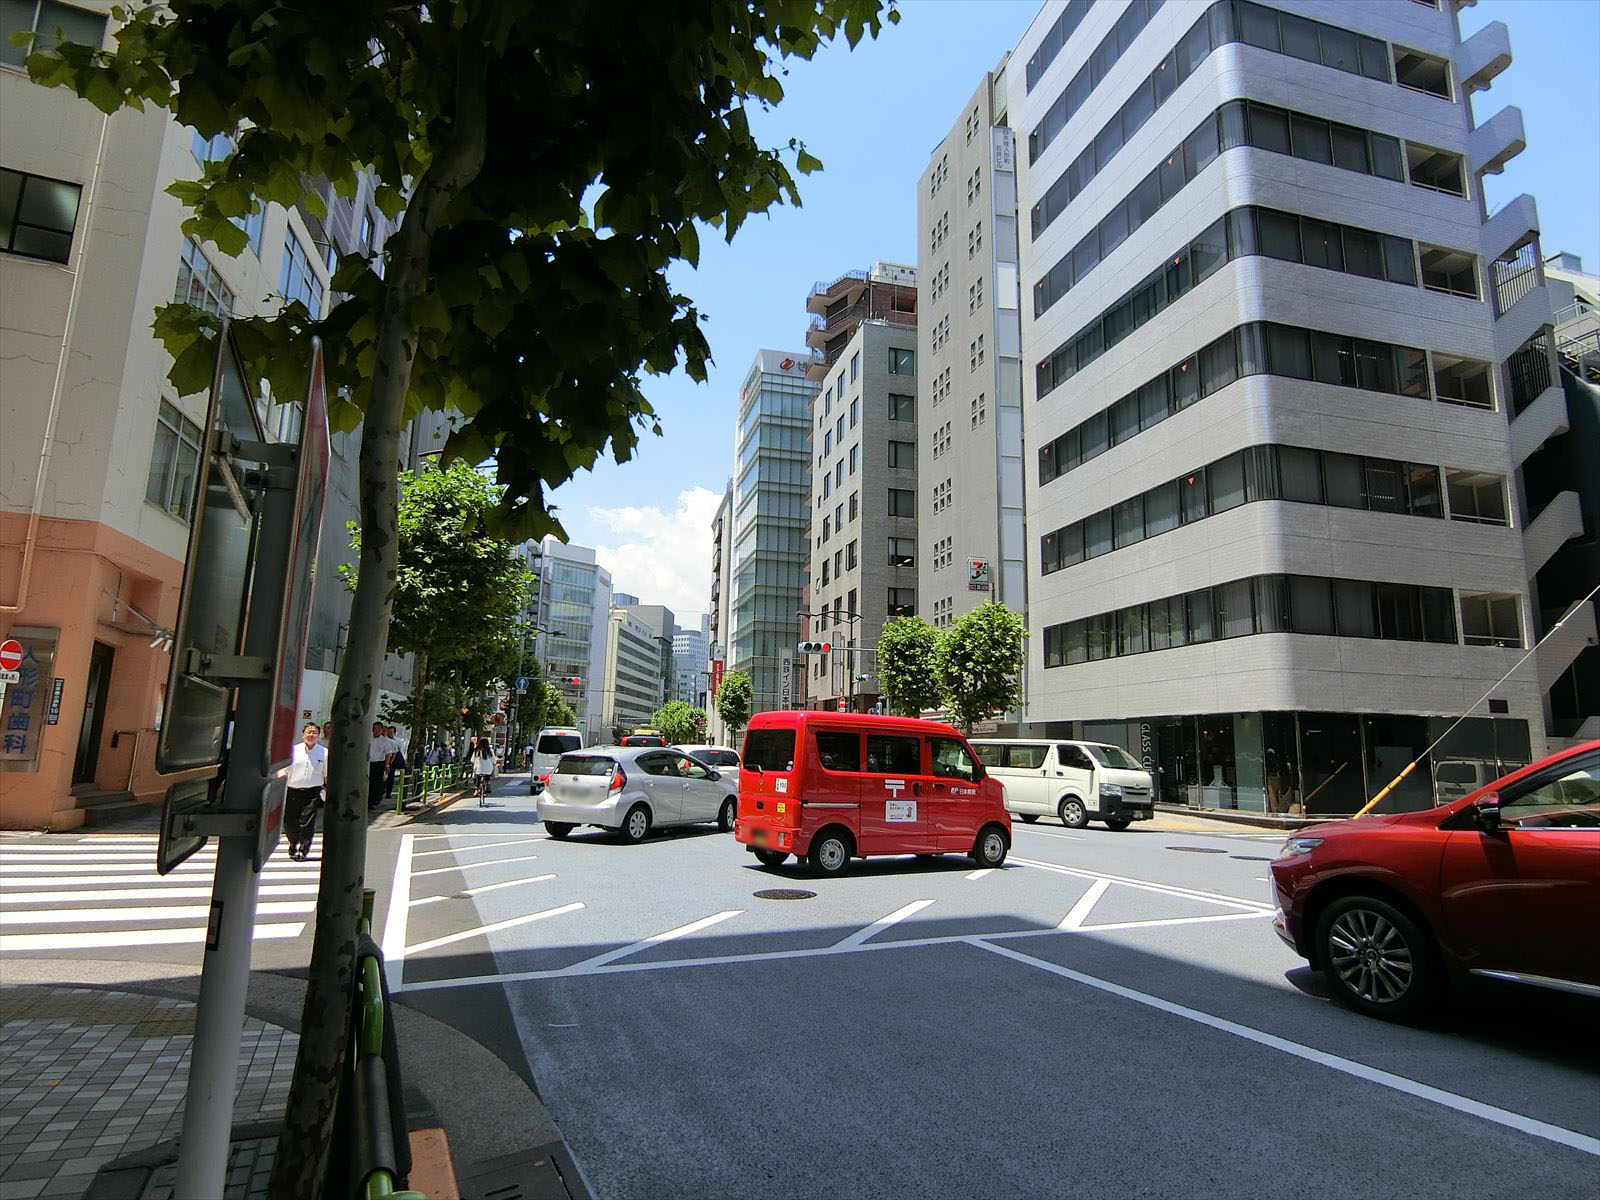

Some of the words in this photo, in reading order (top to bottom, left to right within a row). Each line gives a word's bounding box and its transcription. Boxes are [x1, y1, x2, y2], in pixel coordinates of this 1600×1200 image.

[4, 646, 38, 753] 人形町歯科
[1141, 723, 1151, 752] GLASS
